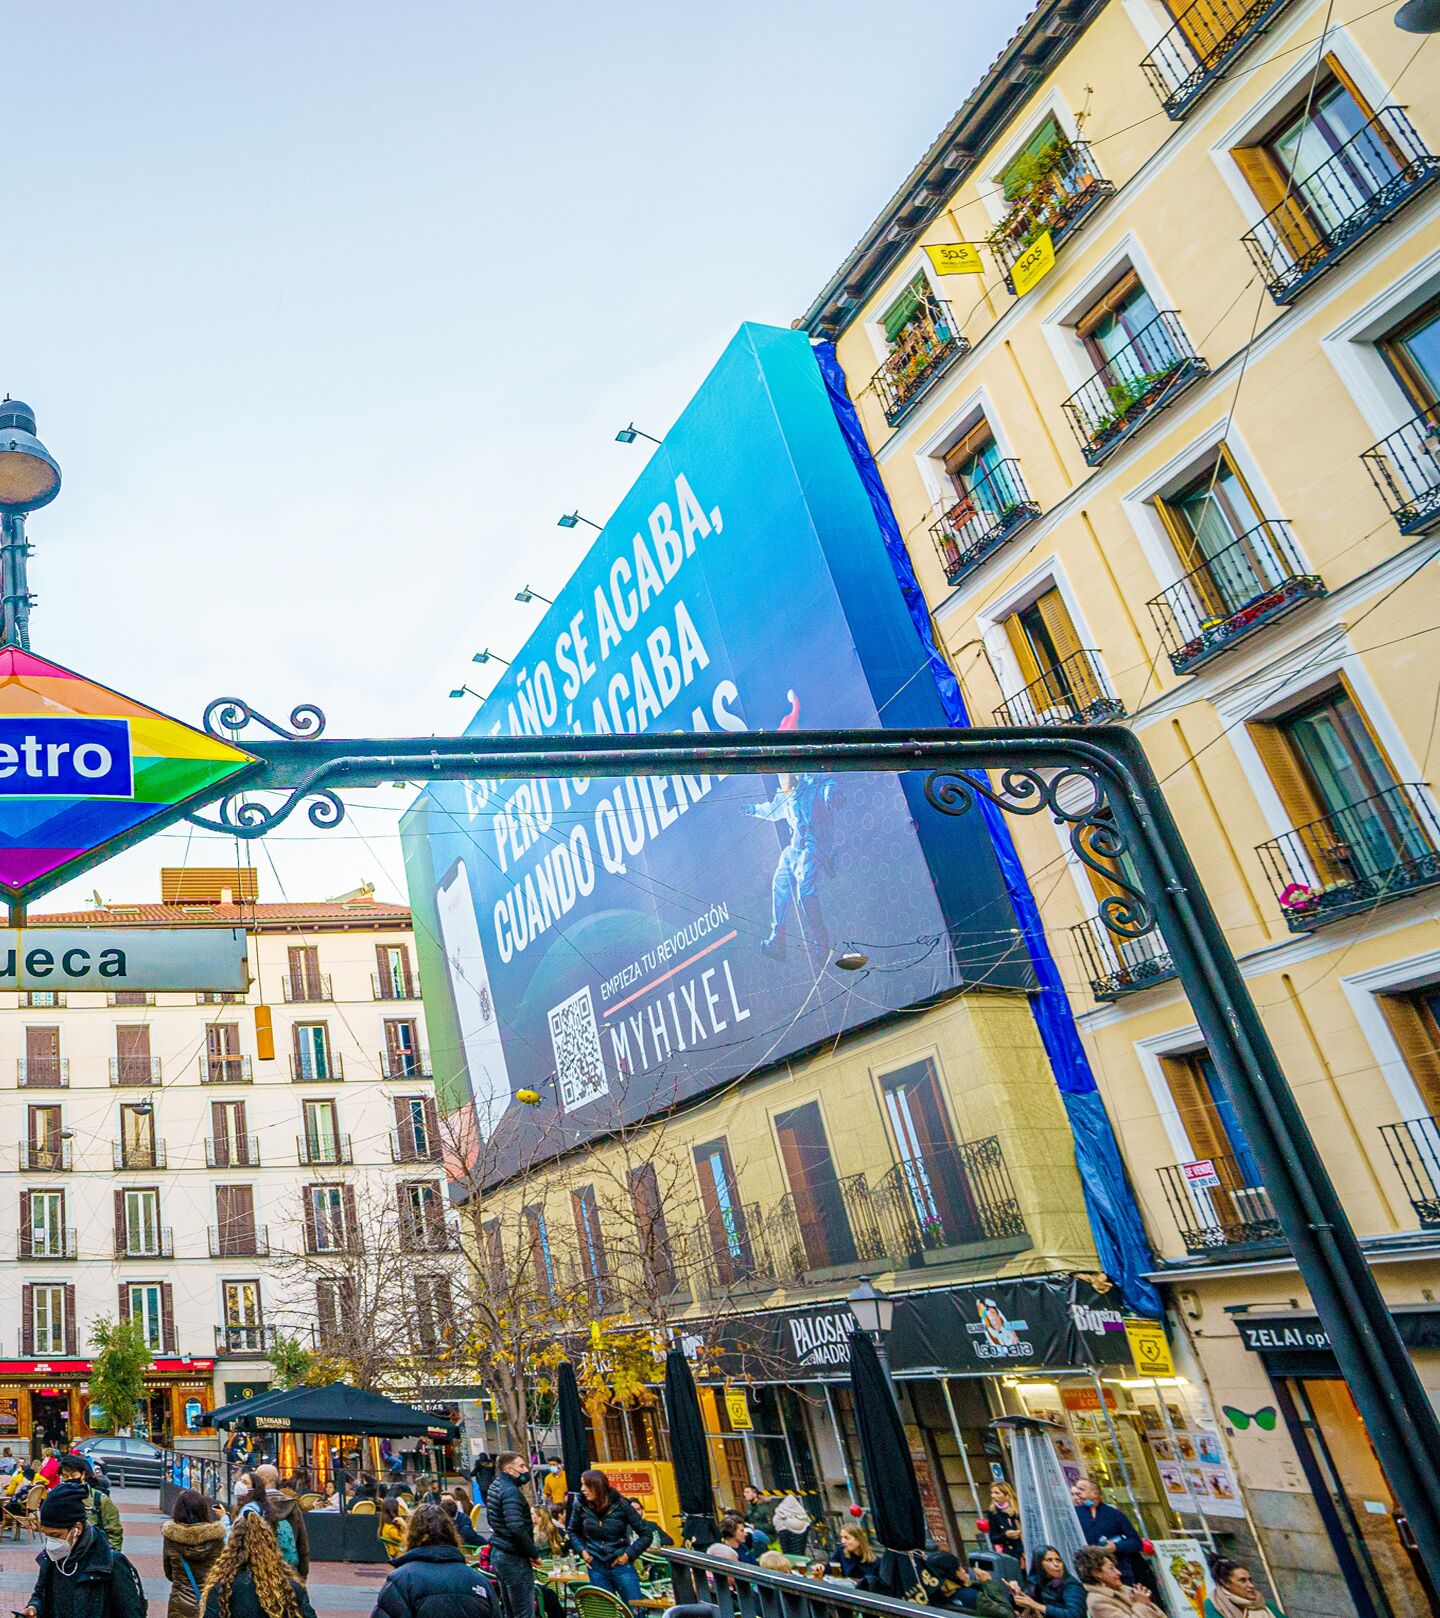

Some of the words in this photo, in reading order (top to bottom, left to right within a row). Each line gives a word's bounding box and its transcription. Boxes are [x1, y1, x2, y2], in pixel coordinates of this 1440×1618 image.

[555, 609, 597, 700] SE
[593, 472, 724, 662] ACABA,
[492, 773, 553, 873] PERO
[593, 600, 711, 735] ACABA
[493, 823, 595, 964] CUANDO
[600, 961, 643, 1001] EMPIEZA
[641, 952, 657, 973] TU
[657, 901, 730, 964] REVOLUCIÓN
[610, 959, 751, 1082] MYHIXEL
[789, 1312, 856, 1358] PALOSAN
[813, 1343, 851, 1365] MADRI
[1246, 1328, 1304, 1346] ZELAI
